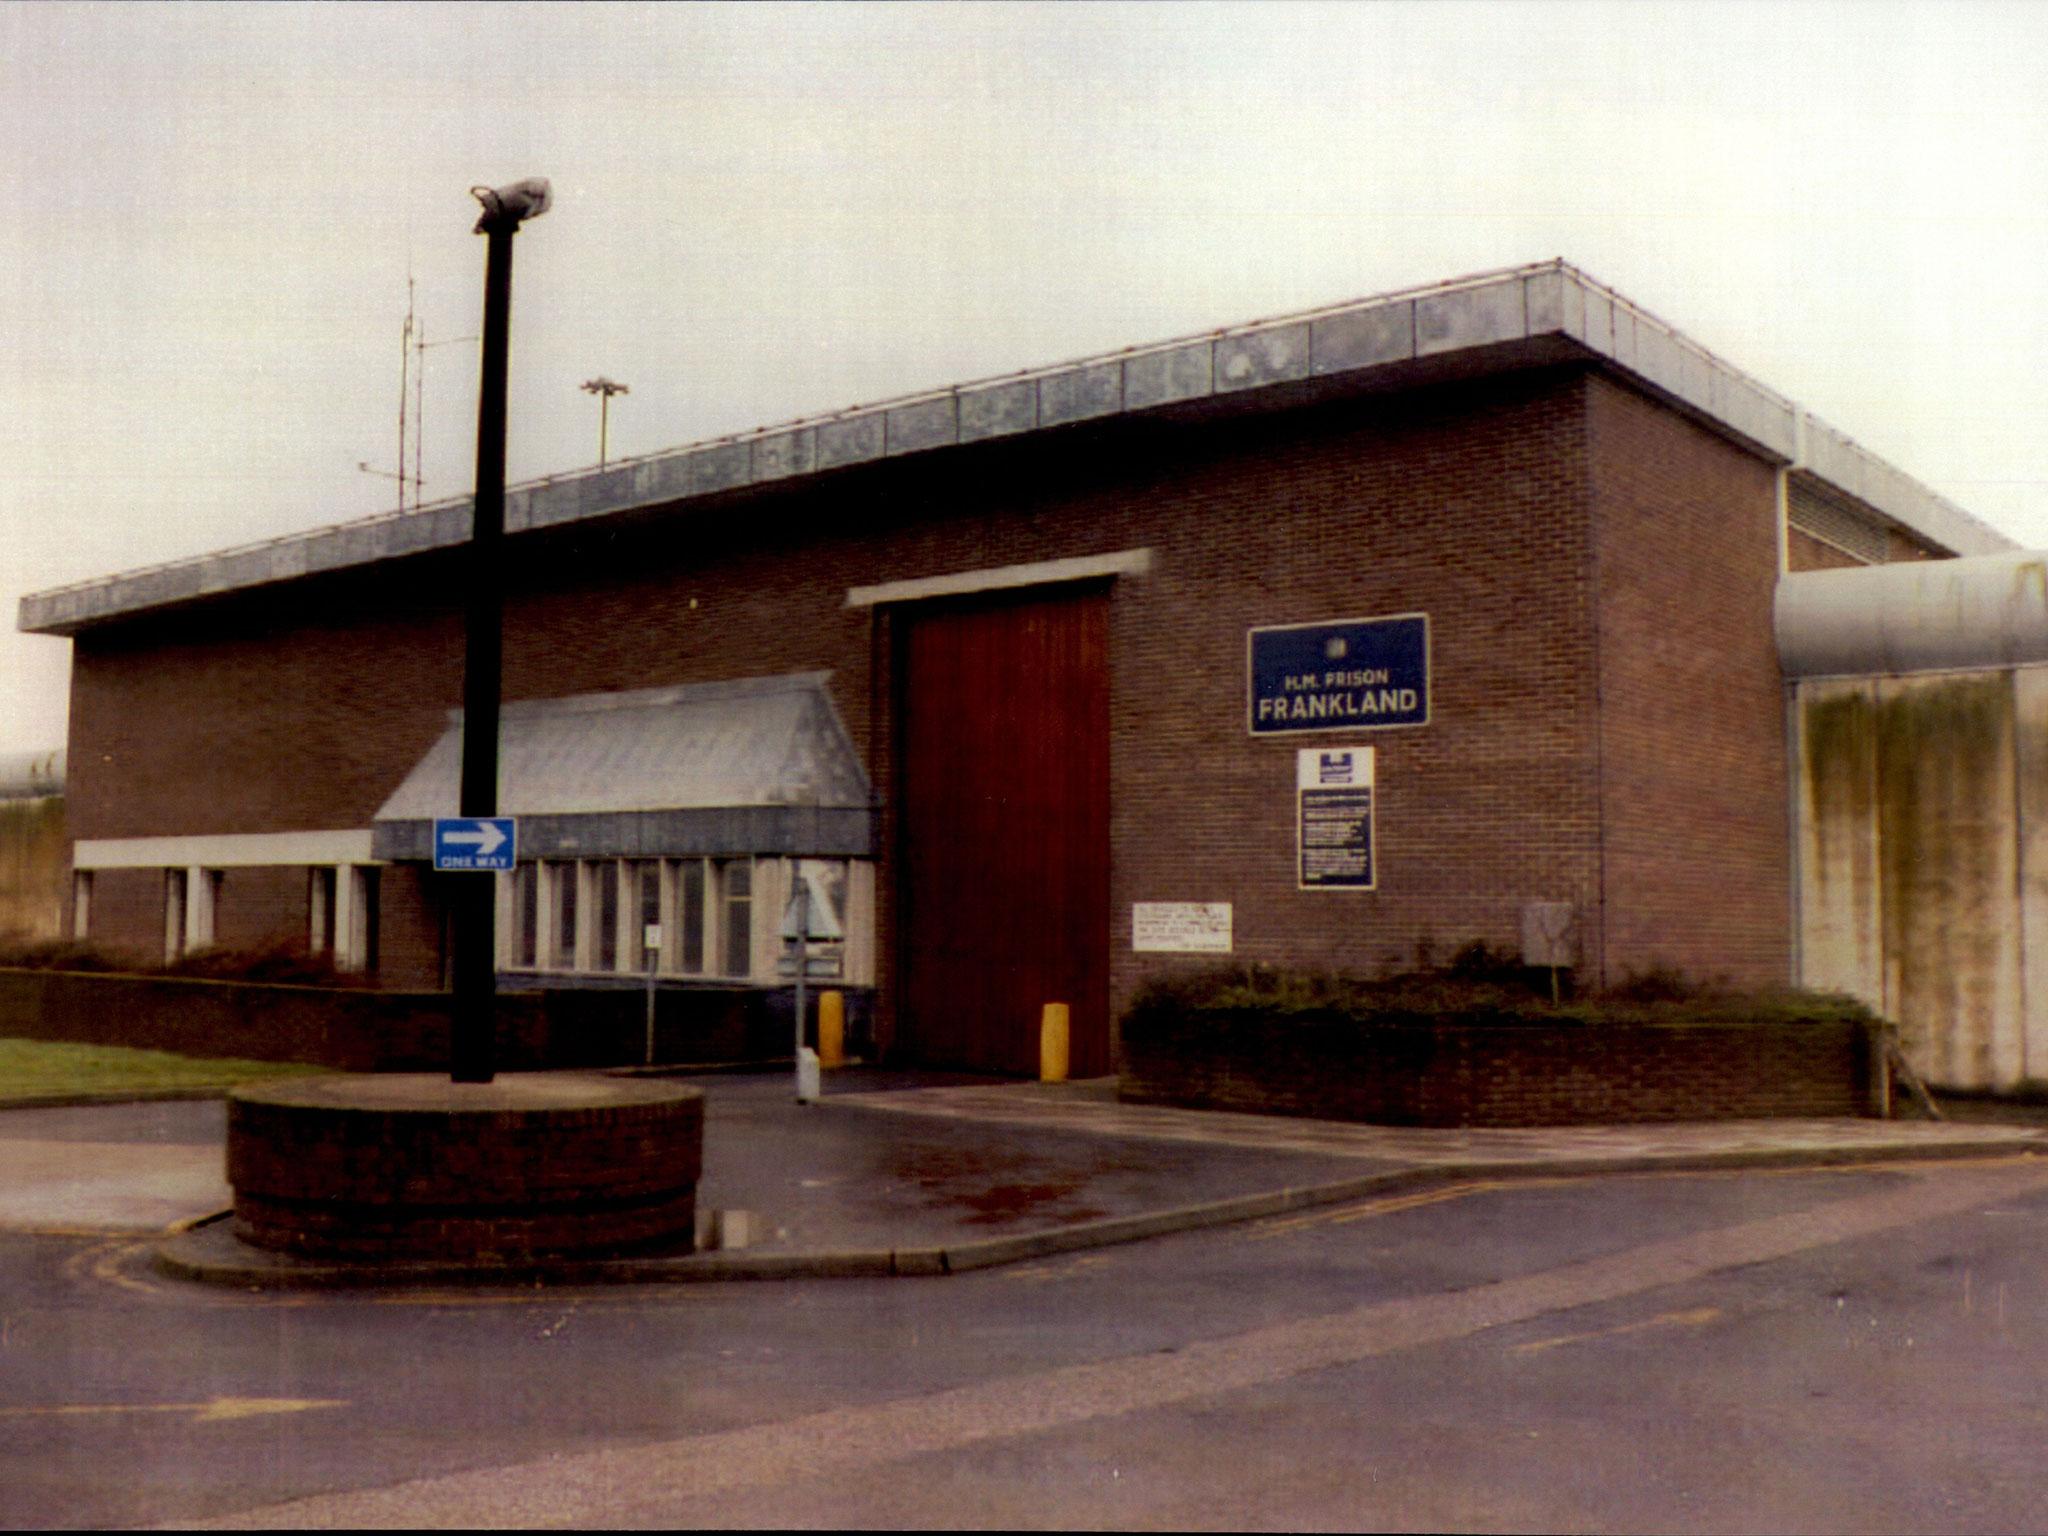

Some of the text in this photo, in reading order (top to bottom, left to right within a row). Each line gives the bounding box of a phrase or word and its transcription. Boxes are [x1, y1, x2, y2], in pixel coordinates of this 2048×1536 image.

[1325, 669, 1389, 687] PRISON
[1258, 688, 1417, 721] FRANKLAND
[441, 856, 507, 868] ONE WAY
